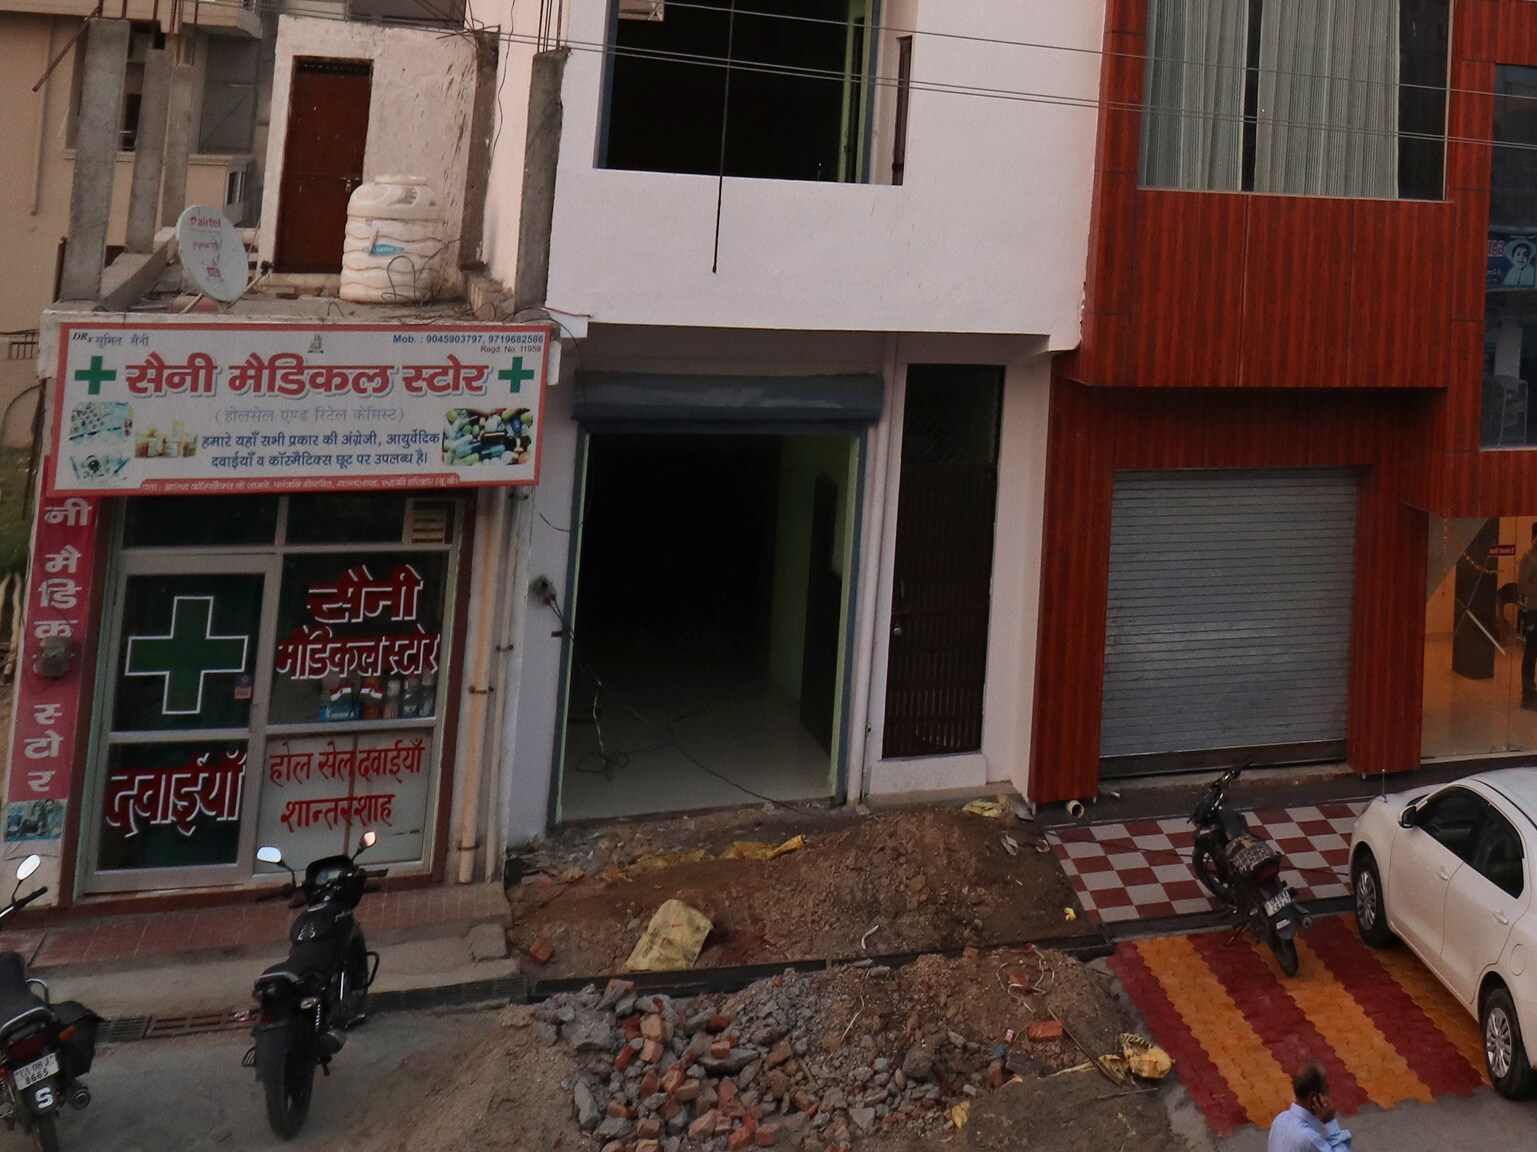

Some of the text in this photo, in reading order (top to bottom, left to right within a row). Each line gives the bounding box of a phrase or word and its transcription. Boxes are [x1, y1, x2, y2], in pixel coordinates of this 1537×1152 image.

[198, 216, 221, 228] airtel
[488, 334, 544, 344] 9719682586
[125, 351, 491, 396] सैनी मैडिकल स्टोर
[201, 432, 232, 448] हमारे
[235, 431, 259, 448] यहाँ
[261, 431, 285, 447] सभी
[289, 434, 319, 447] प्रकार
[323, 431, 337, 446] की
[386, 429, 440, 449] आयुर्वेदिक
[257, 456, 264, 466] व
[336, 454, 353, 469] छूट
[356, 454, 371, 465] पर
[375, 453, 413, 465] उपलब्ध
[306, 564, 424, 623] सैनी
[389, 623, 440, 676] स्टोर
[269, 742, 313, 787] होल
[318, 740, 355, 781] सेल
